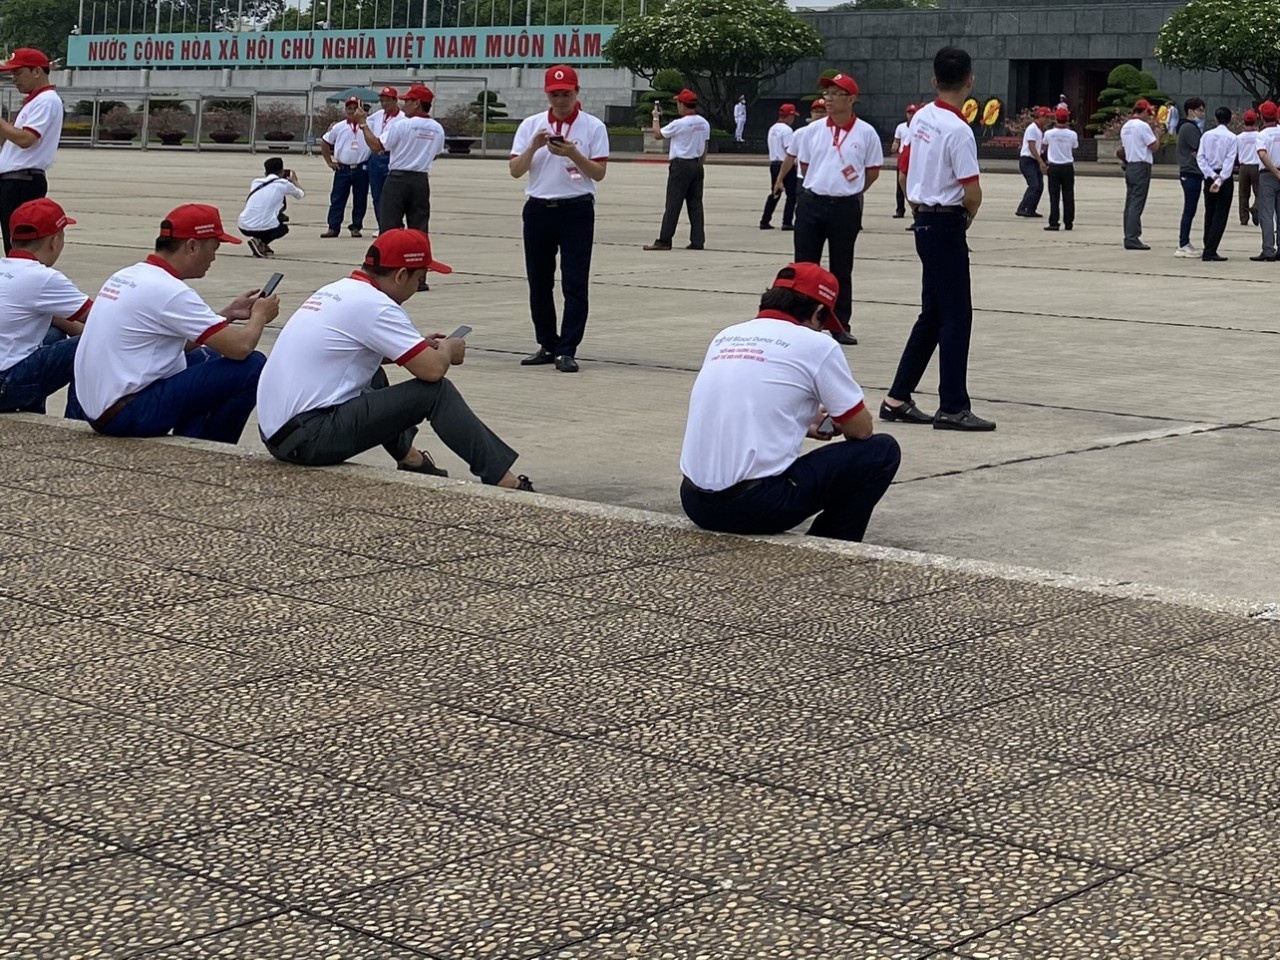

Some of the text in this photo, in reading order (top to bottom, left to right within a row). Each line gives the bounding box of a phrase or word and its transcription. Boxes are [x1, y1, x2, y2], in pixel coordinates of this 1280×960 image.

[88, 28, 601, 65] NƯỚC CỘNG HÒA XÃ HỘI CHỦ NGHĨA VIỆT NAM MUÔN NĂM
